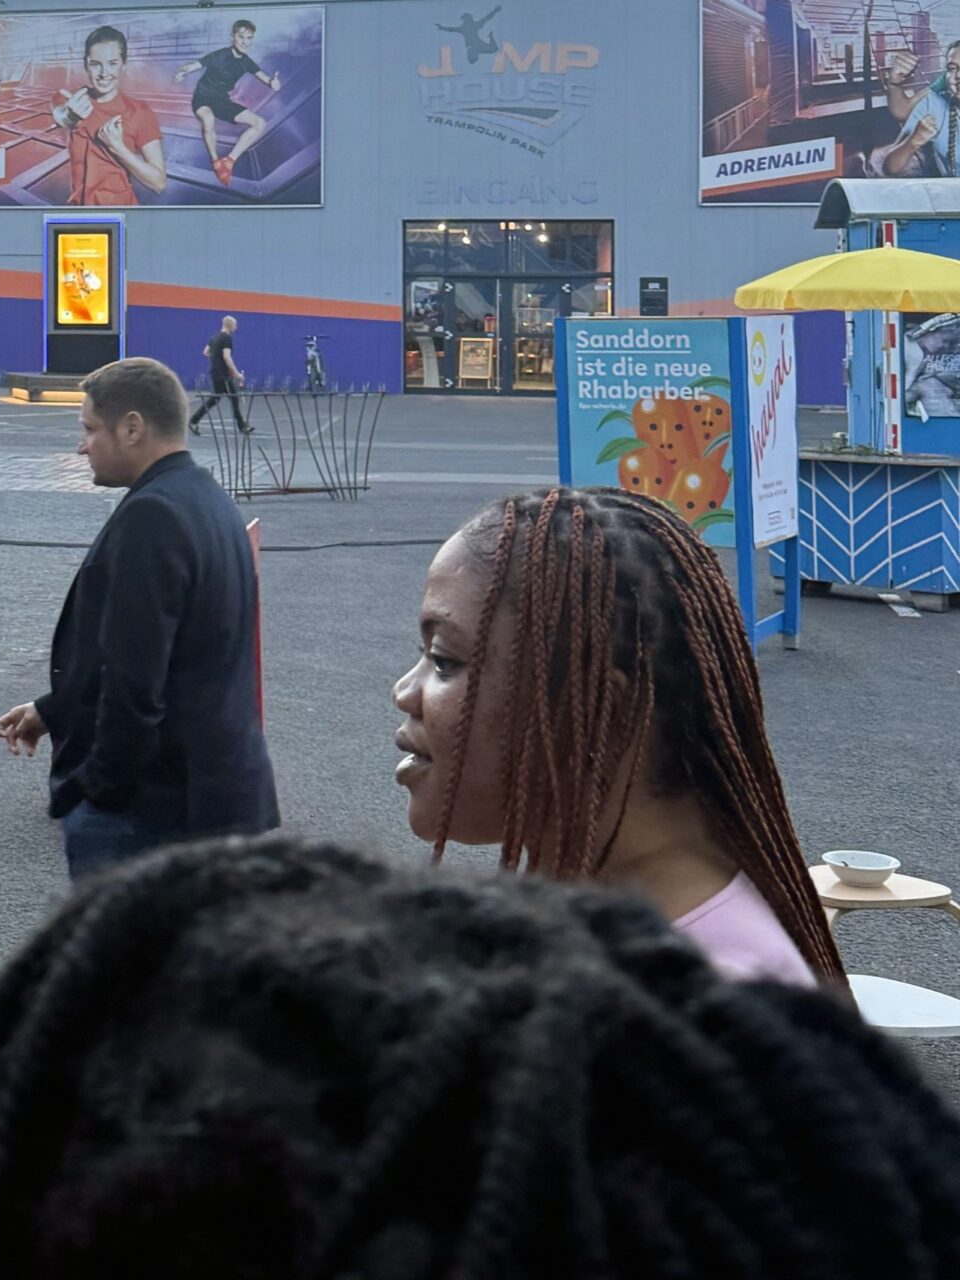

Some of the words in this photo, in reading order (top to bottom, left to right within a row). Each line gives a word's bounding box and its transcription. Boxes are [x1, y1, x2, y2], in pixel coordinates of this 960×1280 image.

[419, 76, 597, 109] HOUSE
[425, 115, 508, 142] TRAMPOLIN
[509, 137, 547, 159] PARK
[715, 147, 826, 179] ADRENALIN
[416, 177, 600, 206] EINGANG
[576, 328, 690, 349] Sanddorn
[577, 357, 607, 377] ist
[612, 356, 648, 377] die
[654, 362, 712, 377] neue
